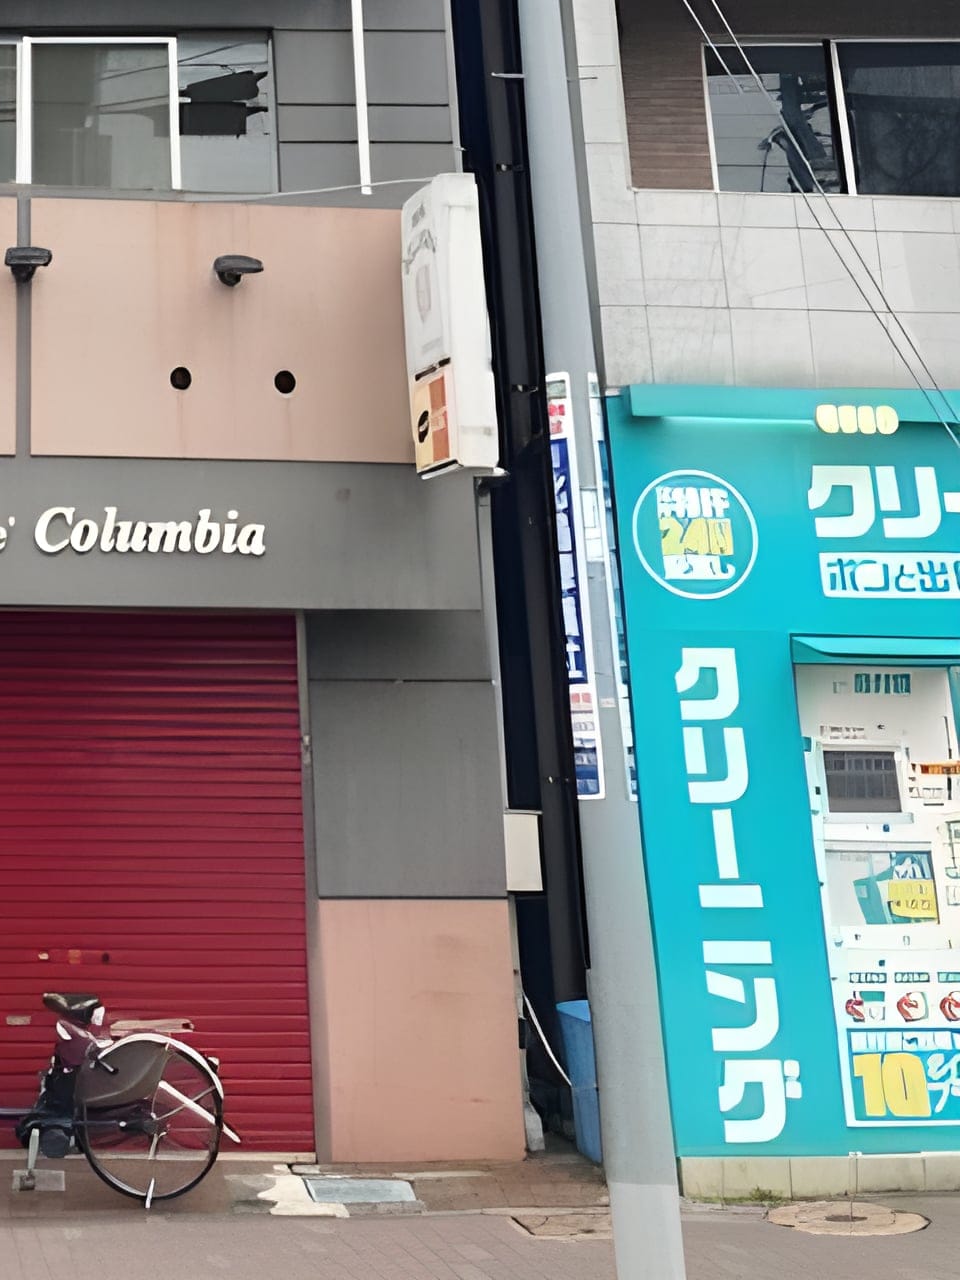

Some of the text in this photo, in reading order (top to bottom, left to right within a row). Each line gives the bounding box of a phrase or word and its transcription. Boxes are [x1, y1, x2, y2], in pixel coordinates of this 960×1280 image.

[34, 506, 266, 555] Columbia
[675, 647, 803, 1143] クリーニング
